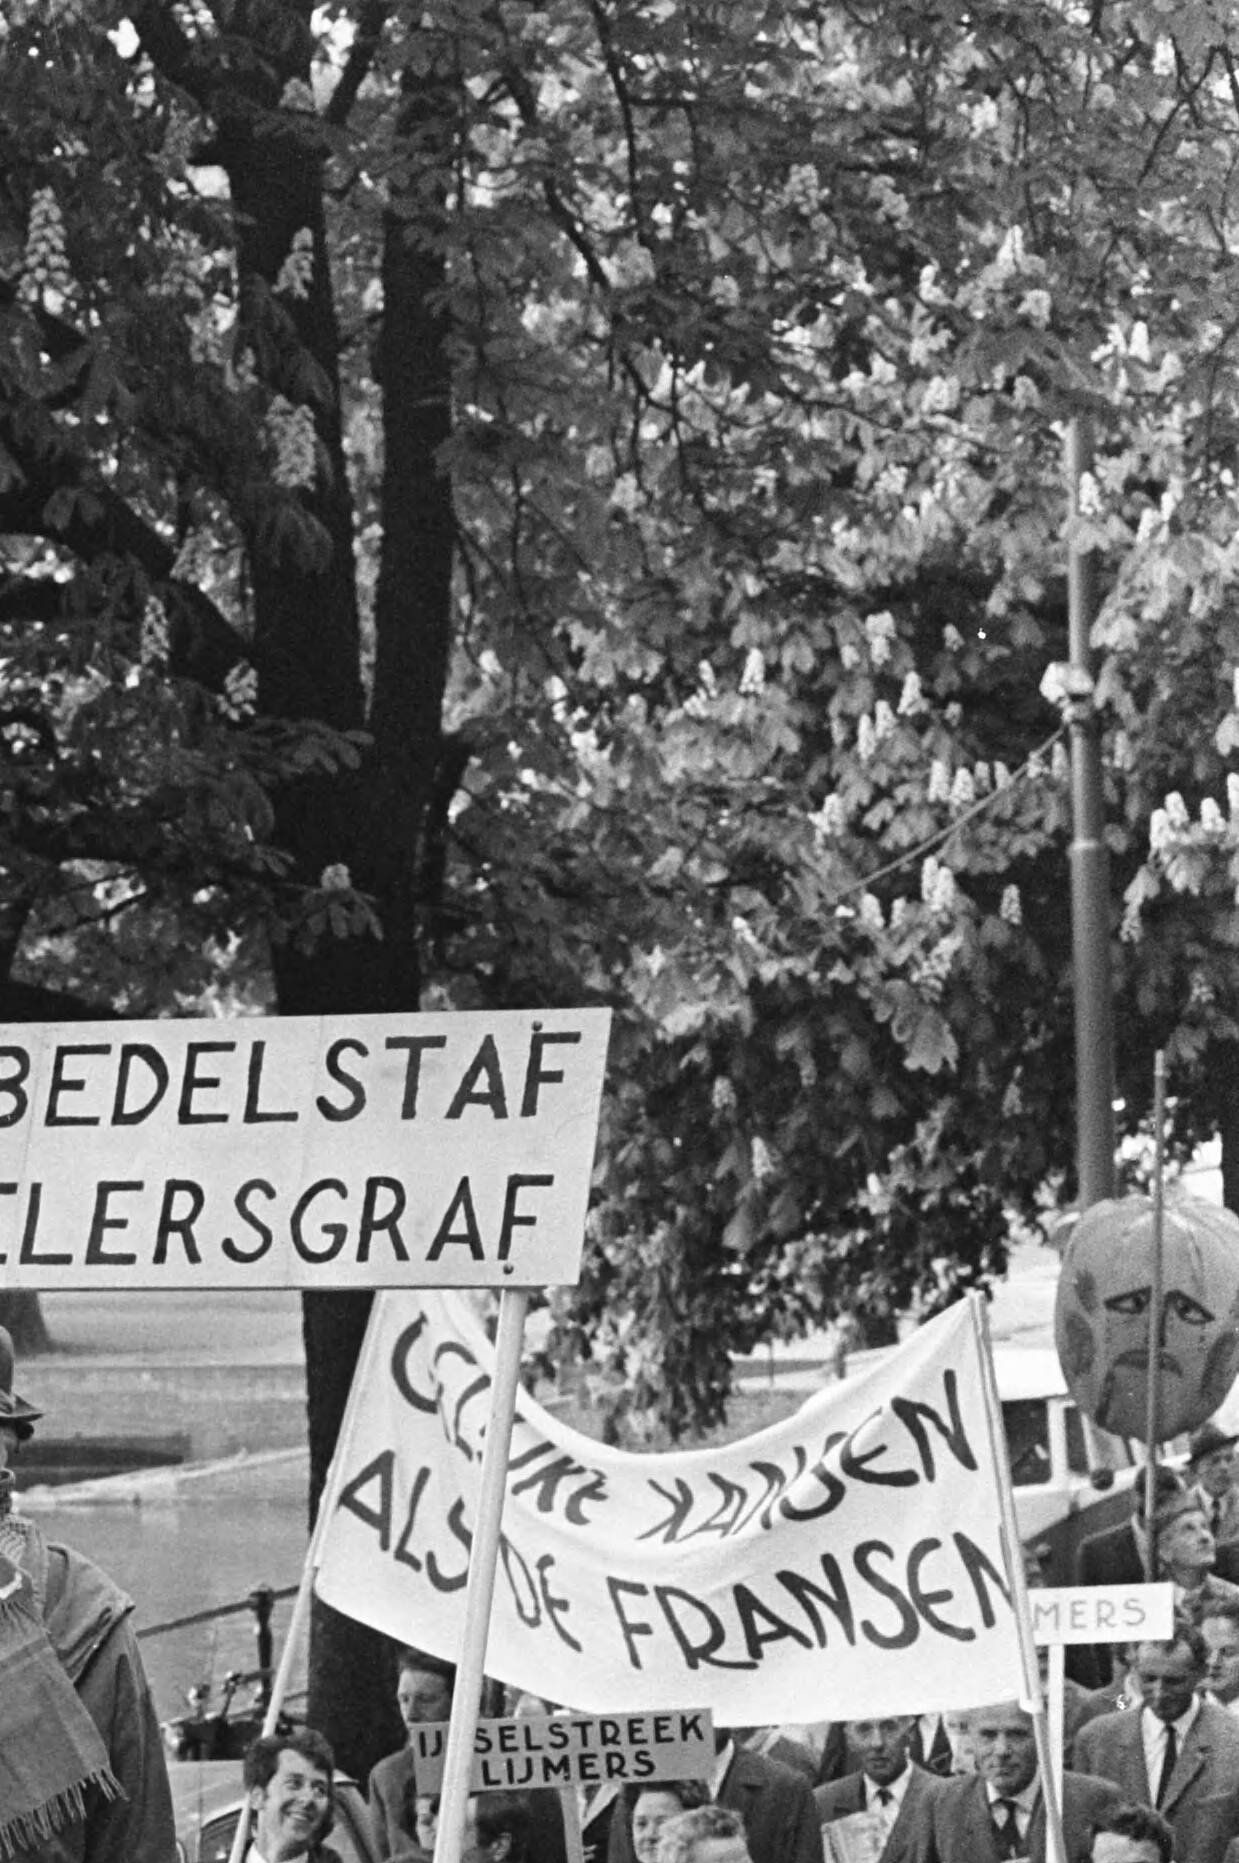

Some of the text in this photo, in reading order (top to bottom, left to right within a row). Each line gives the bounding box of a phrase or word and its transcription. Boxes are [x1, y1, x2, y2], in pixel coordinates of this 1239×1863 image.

[634, 1368, 979, 1545] KANSEN
[336, 1449, 472, 1594] ALS
[606, 1530, 1016, 1672] FRANSEN
[418, 1713, 705, 1759] IJSELSTREEK
[480, 1750, 657, 1786] LIJMERS
